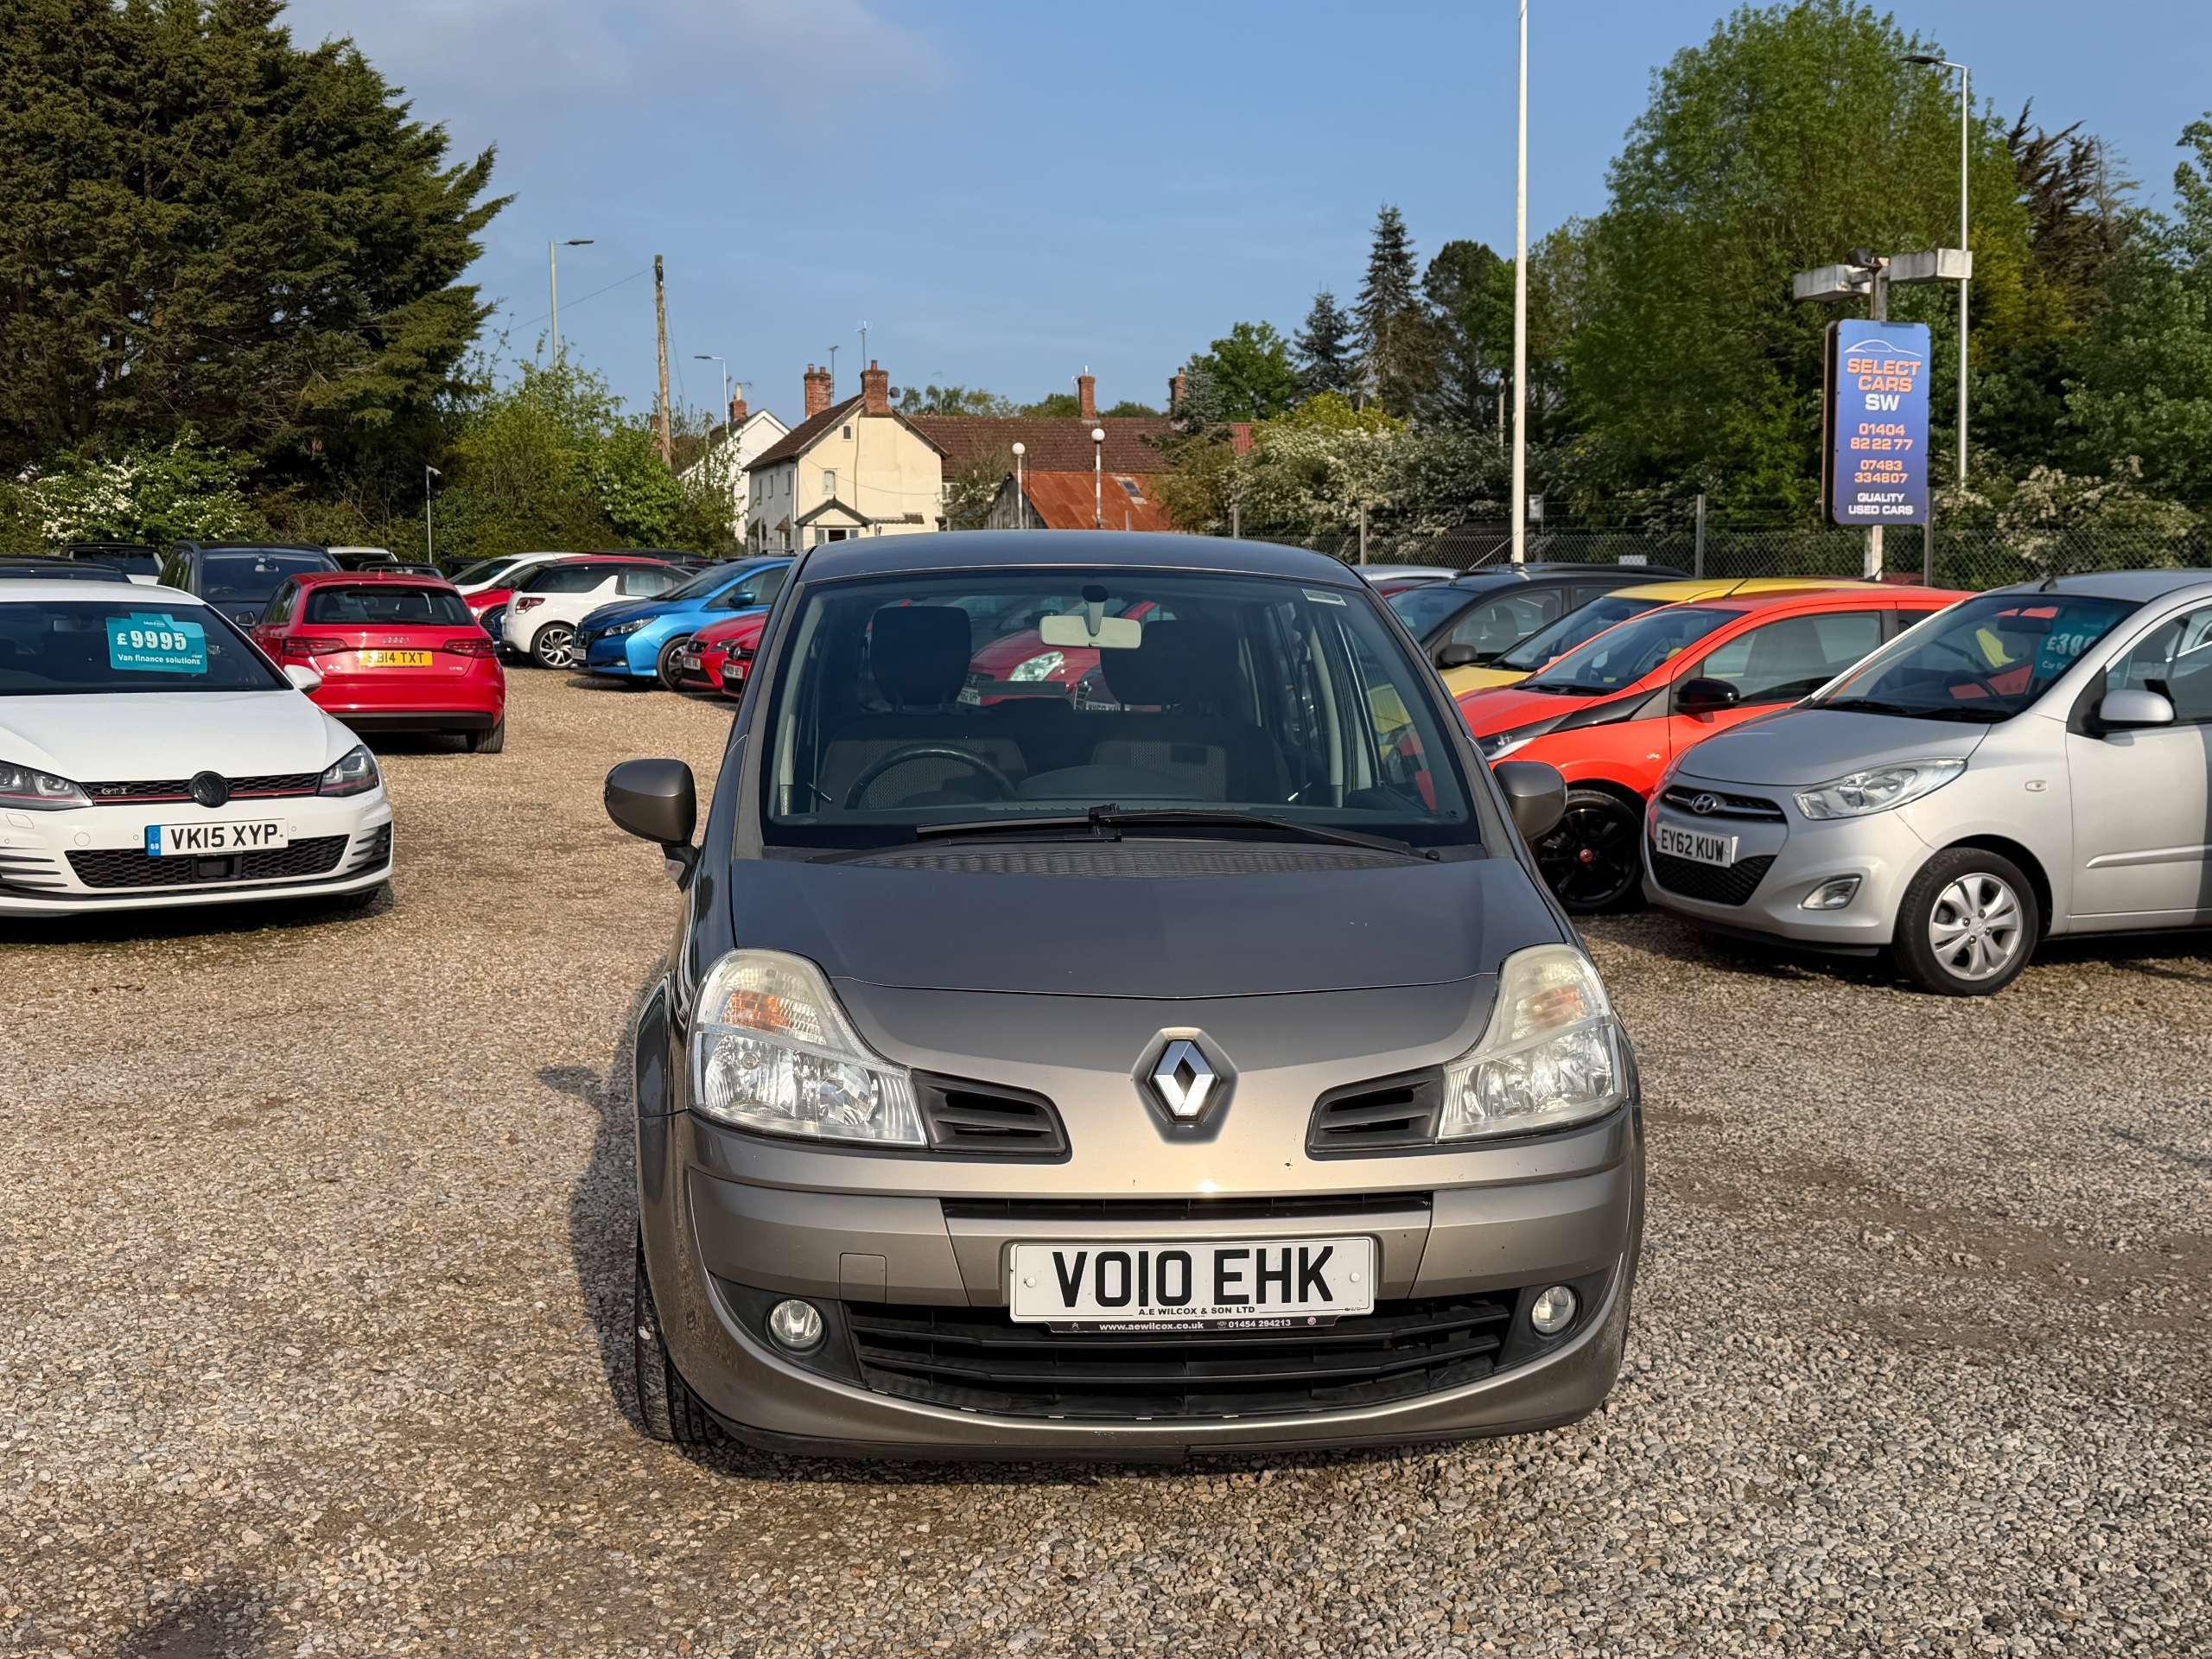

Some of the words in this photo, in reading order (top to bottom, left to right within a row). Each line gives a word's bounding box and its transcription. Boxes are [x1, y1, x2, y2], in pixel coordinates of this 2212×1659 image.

[1847, 358, 1922, 376] SELECT
[1858, 375, 1914, 393] CARS
[1865, 393, 1900, 411] SW
[1859, 423, 1905, 436] 01404
[1860, 460, 1903, 471] 07483
[1857, 493, 1904, 503] QUALITY
[1848, 505, 1879, 514] USED
[1882, 505, 1914, 515] CARS
[118, 653, 133, 662] Van
[135, 654, 164, 664] finance
[165, 656, 201, 665] solutions
[401, 652, 424, 664] TXT
[101, 787, 128, 796] GTI
[170, 826, 226, 850] VK15
[232, 823, 279, 847] XYP
[1661, 829, 1694, 856] EY62
[1696, 836, 1725, 863] KUW
[1052, 1250, 1192, 1308] VO10
[1213, 1245, 1334, 1306] EHK
[1099, 1321, 1205, 1332] www.aewilcox.co.uk
[1228, 1320, 1256, 1329] 01454
[1258, 1319, 1292, 1328] 294213
